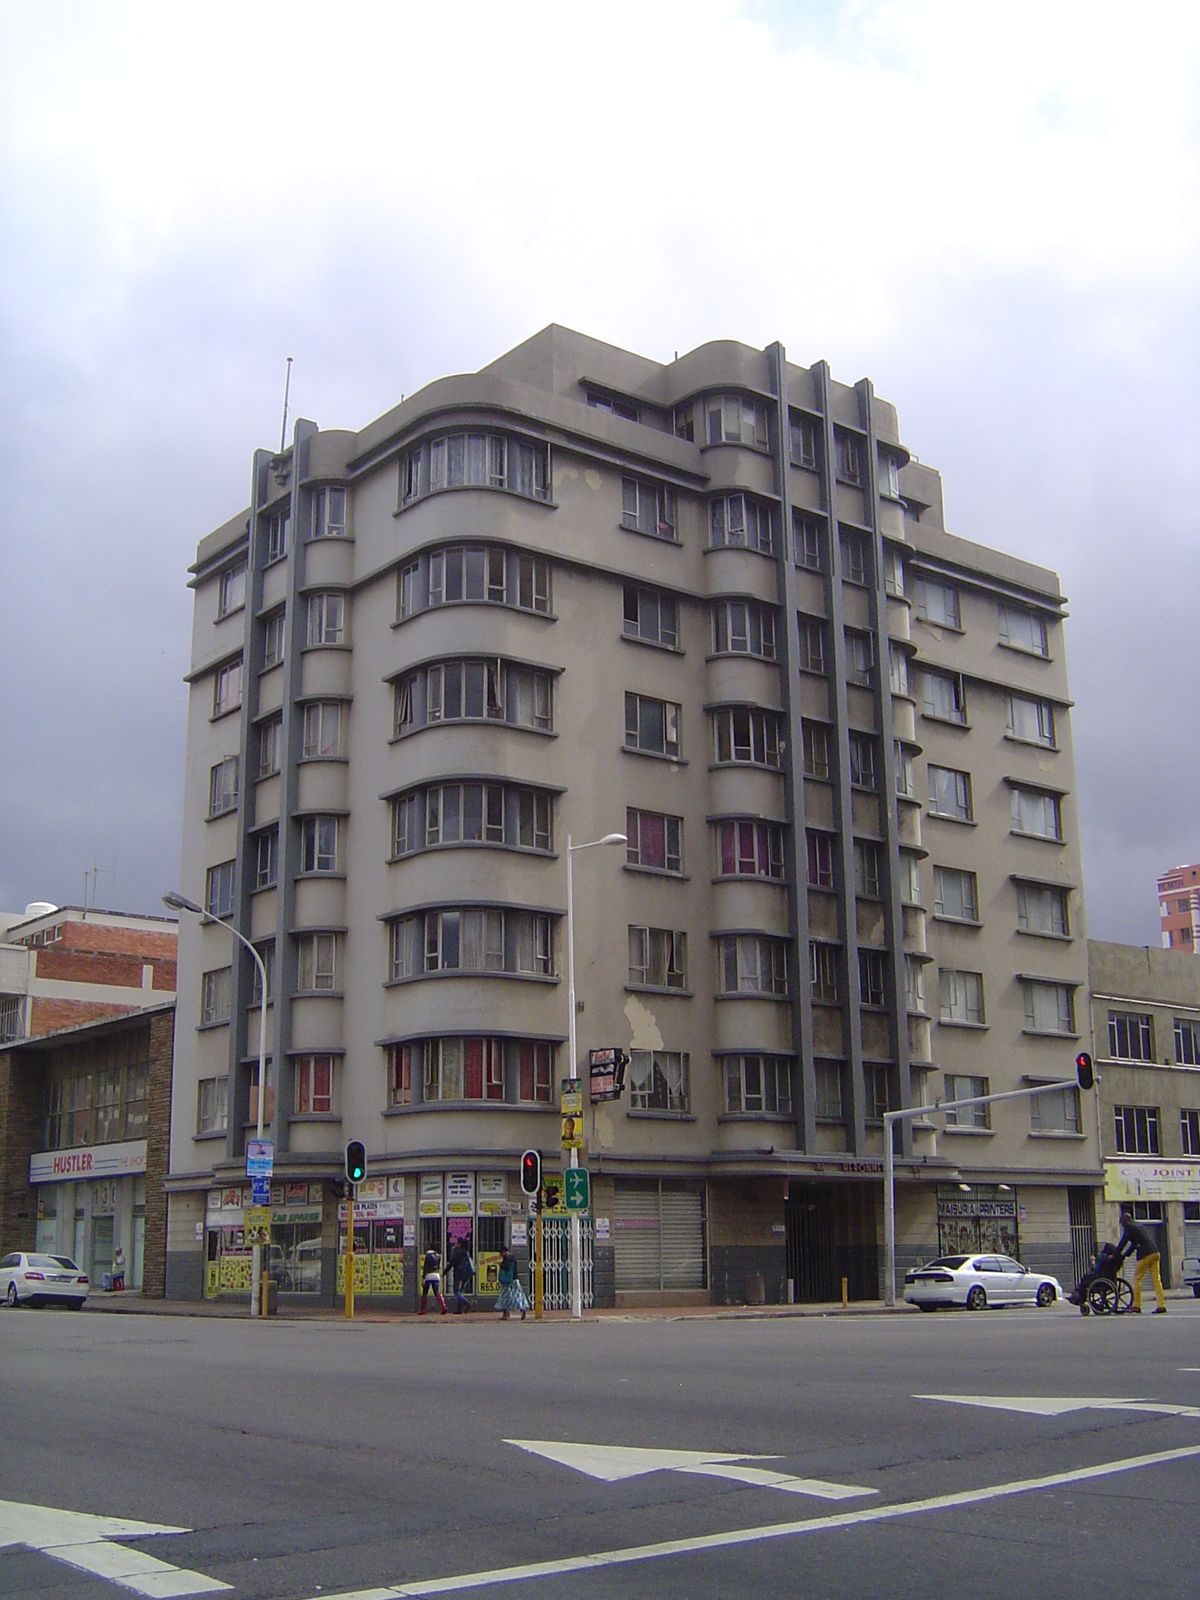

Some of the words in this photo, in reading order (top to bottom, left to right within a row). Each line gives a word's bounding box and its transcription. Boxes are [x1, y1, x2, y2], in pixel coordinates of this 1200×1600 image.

[53, 1153, 93, 1173] HUSTLER
[1152, 1169, 1192, 1177] JOINT
[361, 1202, 378, 1210] PLATES
[939, 1203, 975, 1215] MAISURIA
[979, 1203, 1014, 1215] PRINTERS
[272, 1213, 287, 1222] CAR
[480, 1282, 501, 1292] R65.0
